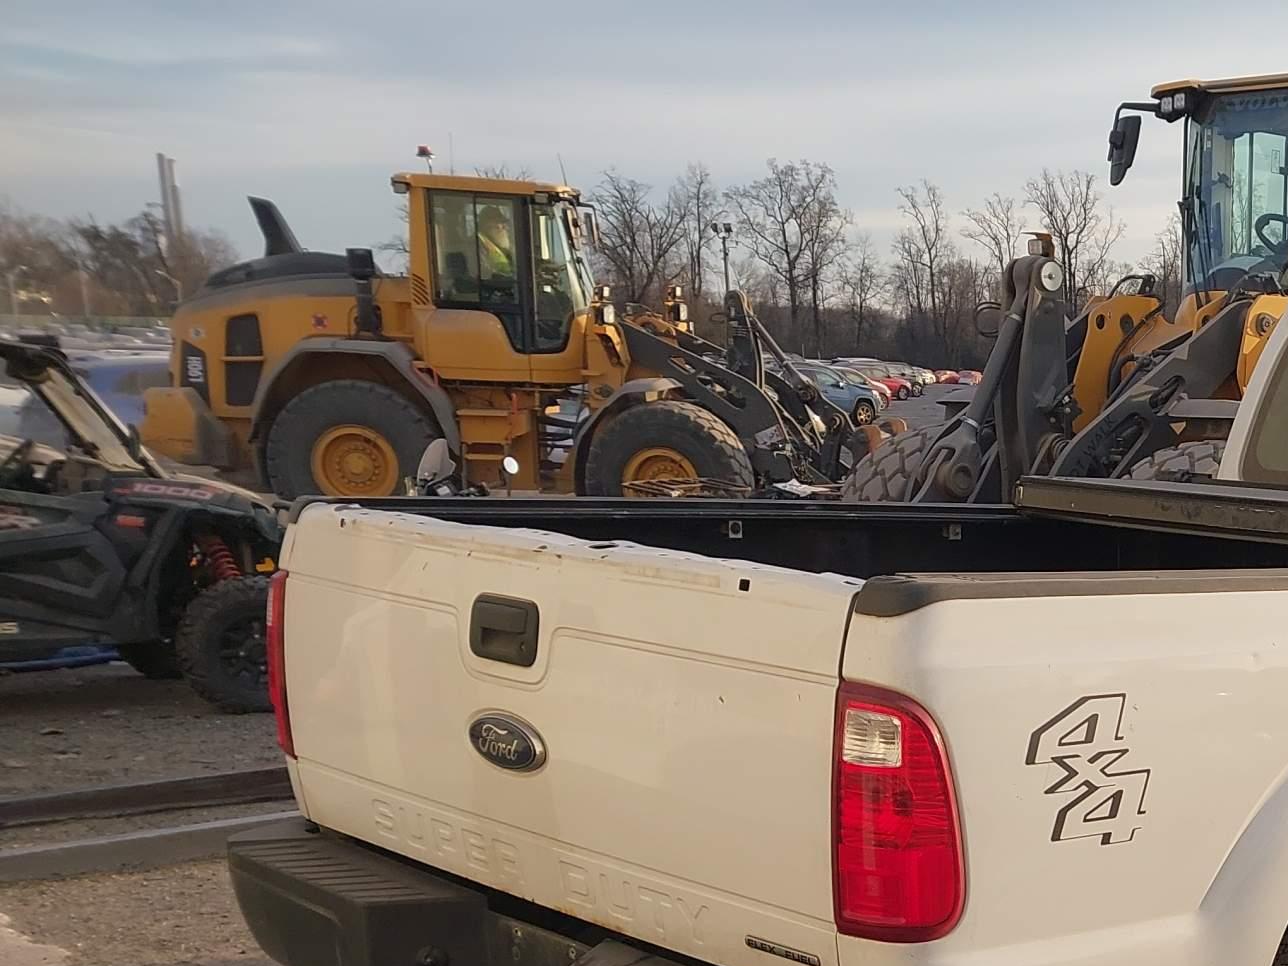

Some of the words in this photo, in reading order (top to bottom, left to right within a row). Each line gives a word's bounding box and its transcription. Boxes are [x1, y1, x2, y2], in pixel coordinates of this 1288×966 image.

[132, 482, 213, 500] 1000
[478, 723, 518, 761] Ford
[371, 798, 525, 886] SUPER
[559, 859, 710, 945] DUTY
[746, 938, 777, 955] FLEX
